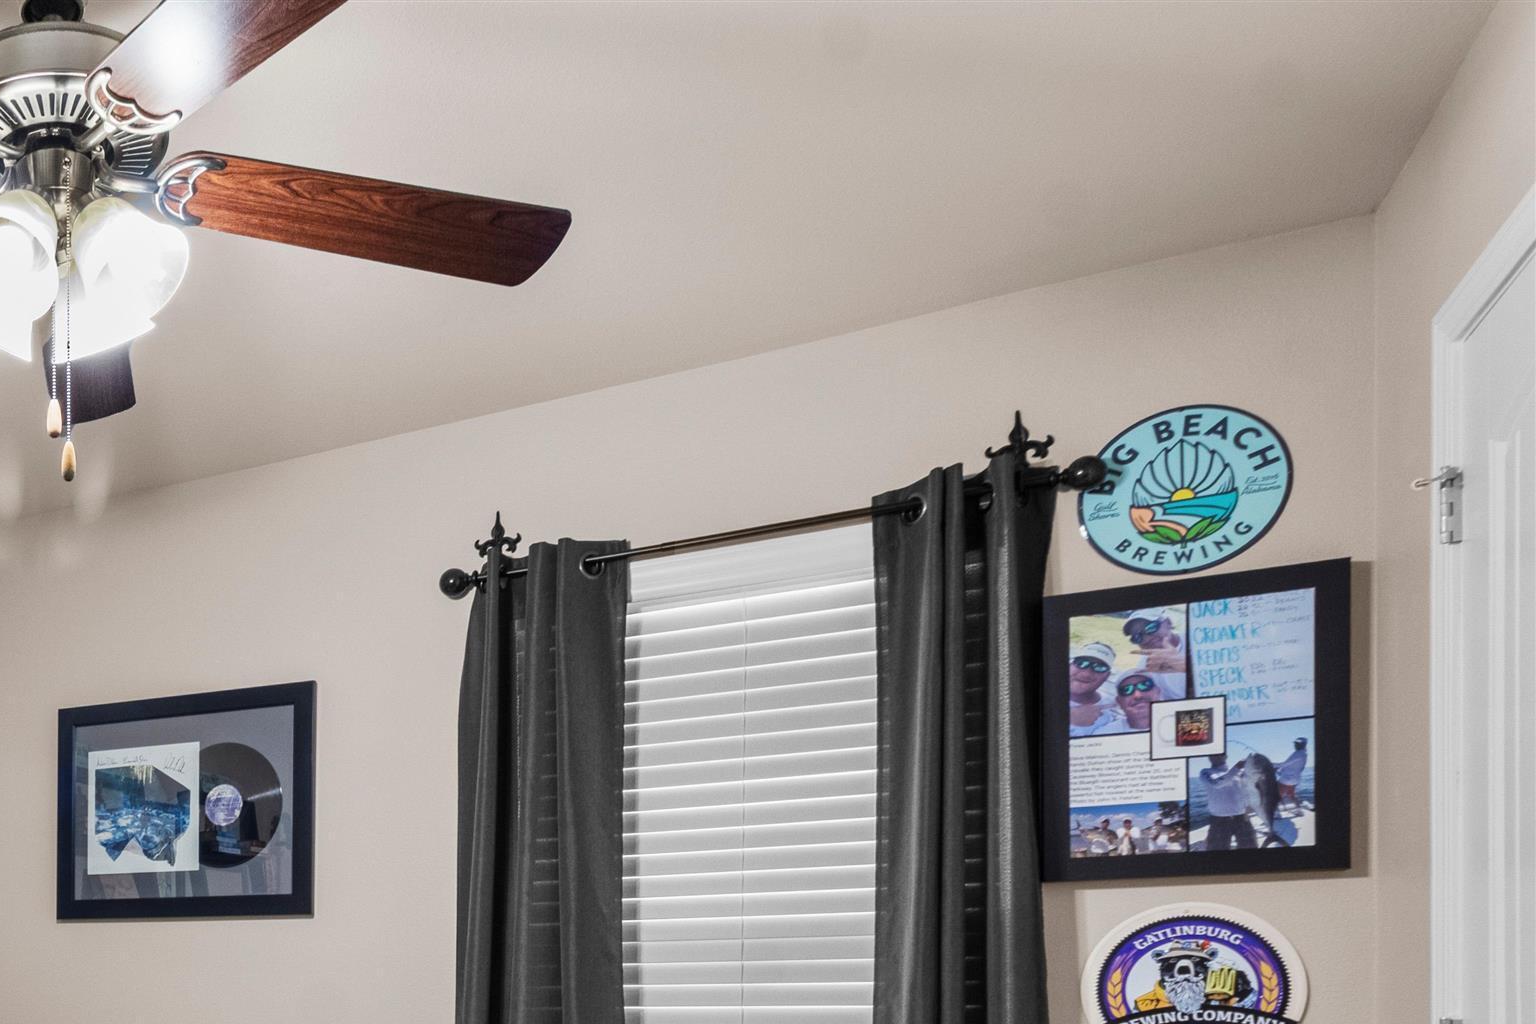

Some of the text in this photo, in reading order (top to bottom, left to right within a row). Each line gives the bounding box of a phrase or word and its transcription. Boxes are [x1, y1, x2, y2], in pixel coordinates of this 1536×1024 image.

[1087, 413, 1282, 495] BIG BEACH
[1113, 520, 1253, 565] BREWING
[1133, 924, 1244, 950] GATLINBURG
